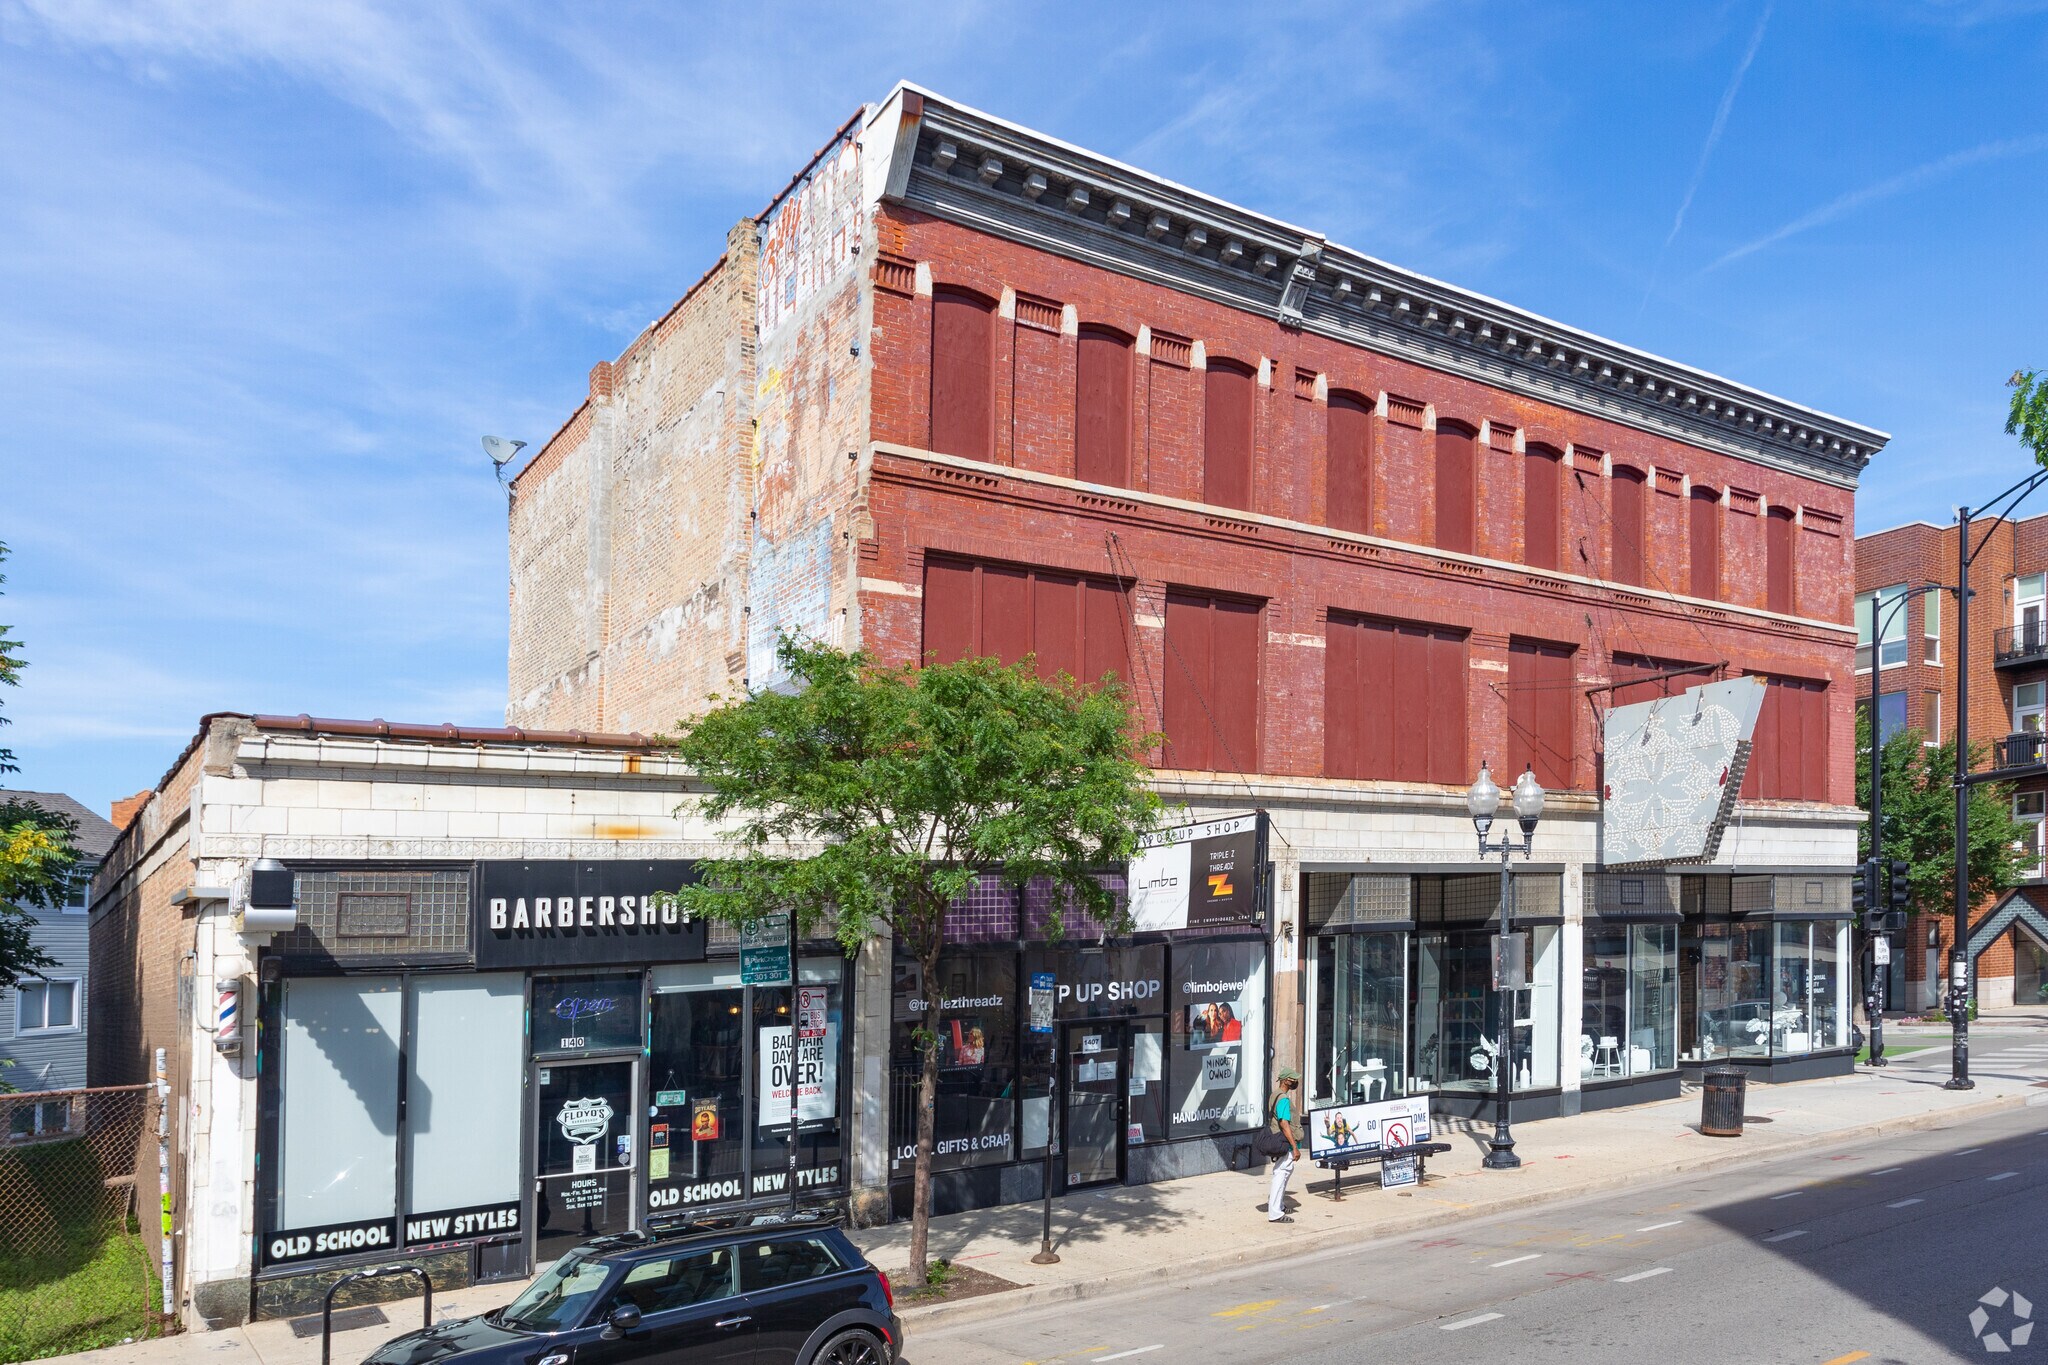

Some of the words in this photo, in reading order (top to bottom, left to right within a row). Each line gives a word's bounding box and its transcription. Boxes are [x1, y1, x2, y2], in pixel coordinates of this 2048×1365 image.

[1179, 828, 1194, 840] UP
[1206, 821, 1240, 836] SHOP
[1210, 851, 1229, 860] TRIPLE
[1231, 850, 1235, 858] Z
[1209, 862, 1235, 872] THREADZ
[490, 895, 691, 930] BARBERSHO
[1076, 982, 1102, 1002] UP
[1107, 979, 1161, 1001] SHOP
[1183, 979, 1249, 994] @limbojewelr
[908, 994, 1003, 1011] @trlezthreadz
[810, 1011, 821, 1019] BUS
[810, 1020, 823, 1028] STOP
[773, 1035, 792, 1050] BAD
[1084, 1038, 1100, 1046] 1407
[772, 1049, 799, 1065] DAY
[802, 1046, 823, 1062] ARE
[1206, 1057, 1236, 1069] MINORITY
[772, 1061, 823, 1088] OVER!
[1209, 1069, 1232, 1080] OWNED
[564, 1109, 605, 1122] FLOYD'S
[1173, 1107, 1221, 1124] HANDMADE
[1222, 1103, 1255, 1118] JEWELR
[1413, 1112, 1427, 1124] OME
[1128, 1127, 1141, 1137] ORRY
[1367, 1120, 1376, 1130] GO
[897, 1144, 935, 1160] LOC
[937, 1138, 969, 1155] GIFTS
[971, 1137, 979, 1150] &
[981, 1133, 1011, 1149] CRAP
[572, 1178, 598, 1189] HOURS
[649, 1188, 680, 1208] OLD
[683, 1179, 742, 1204] SCHOOL
[753, 1173, 786, 1193] NEW
[796, 1166, 838, 1187] TYLES
[271, 1236, 311, 1259] OLD
[315, 1225, 390, 1251] SCHOOL
[406, 1217, 450, 1241] NEW
[454, 1208, 518, 1235] STYLES
